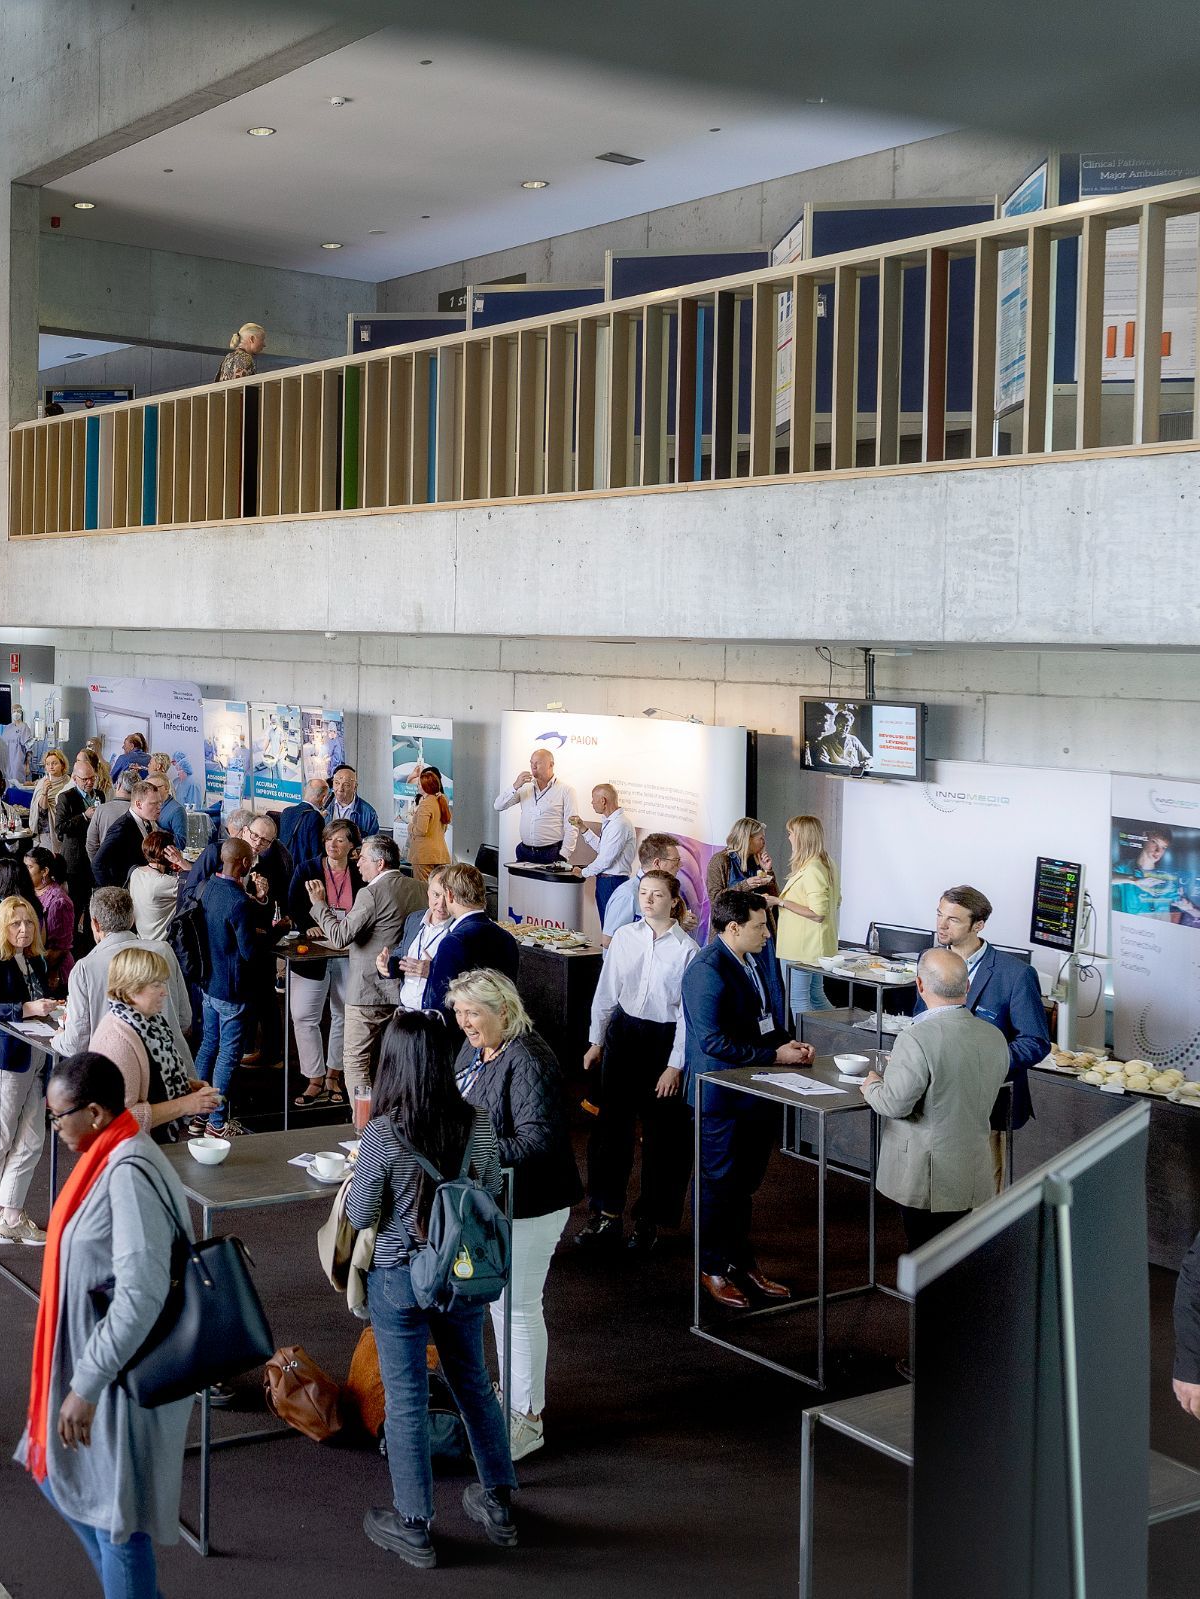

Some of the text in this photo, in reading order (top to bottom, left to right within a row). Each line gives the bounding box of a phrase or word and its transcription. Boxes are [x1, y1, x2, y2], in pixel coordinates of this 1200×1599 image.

[1082, 160, 1115, 169] Clinical
[1100, 171, 1126, 180] Major
[1128, 169, 1182, 178] Ambulatory
[155, 710, 198, 722] Imagine Zero
[164, 722, 199, 733] Infections.
[570, 736, 598, 746] PAION
[256, 781, 278, 789] ACCURACY
[256, 788, 301, 800] IMPROVES OUTCOMES
[936, 791, 1010, 804] INNOMEDIQ
[527, 916, 565, 930] PAION
[1120, 926, 1155, 938] Innovation
[1120, 948, 1144, 960] Service
[1120, 961, 1151, 976] Academy
